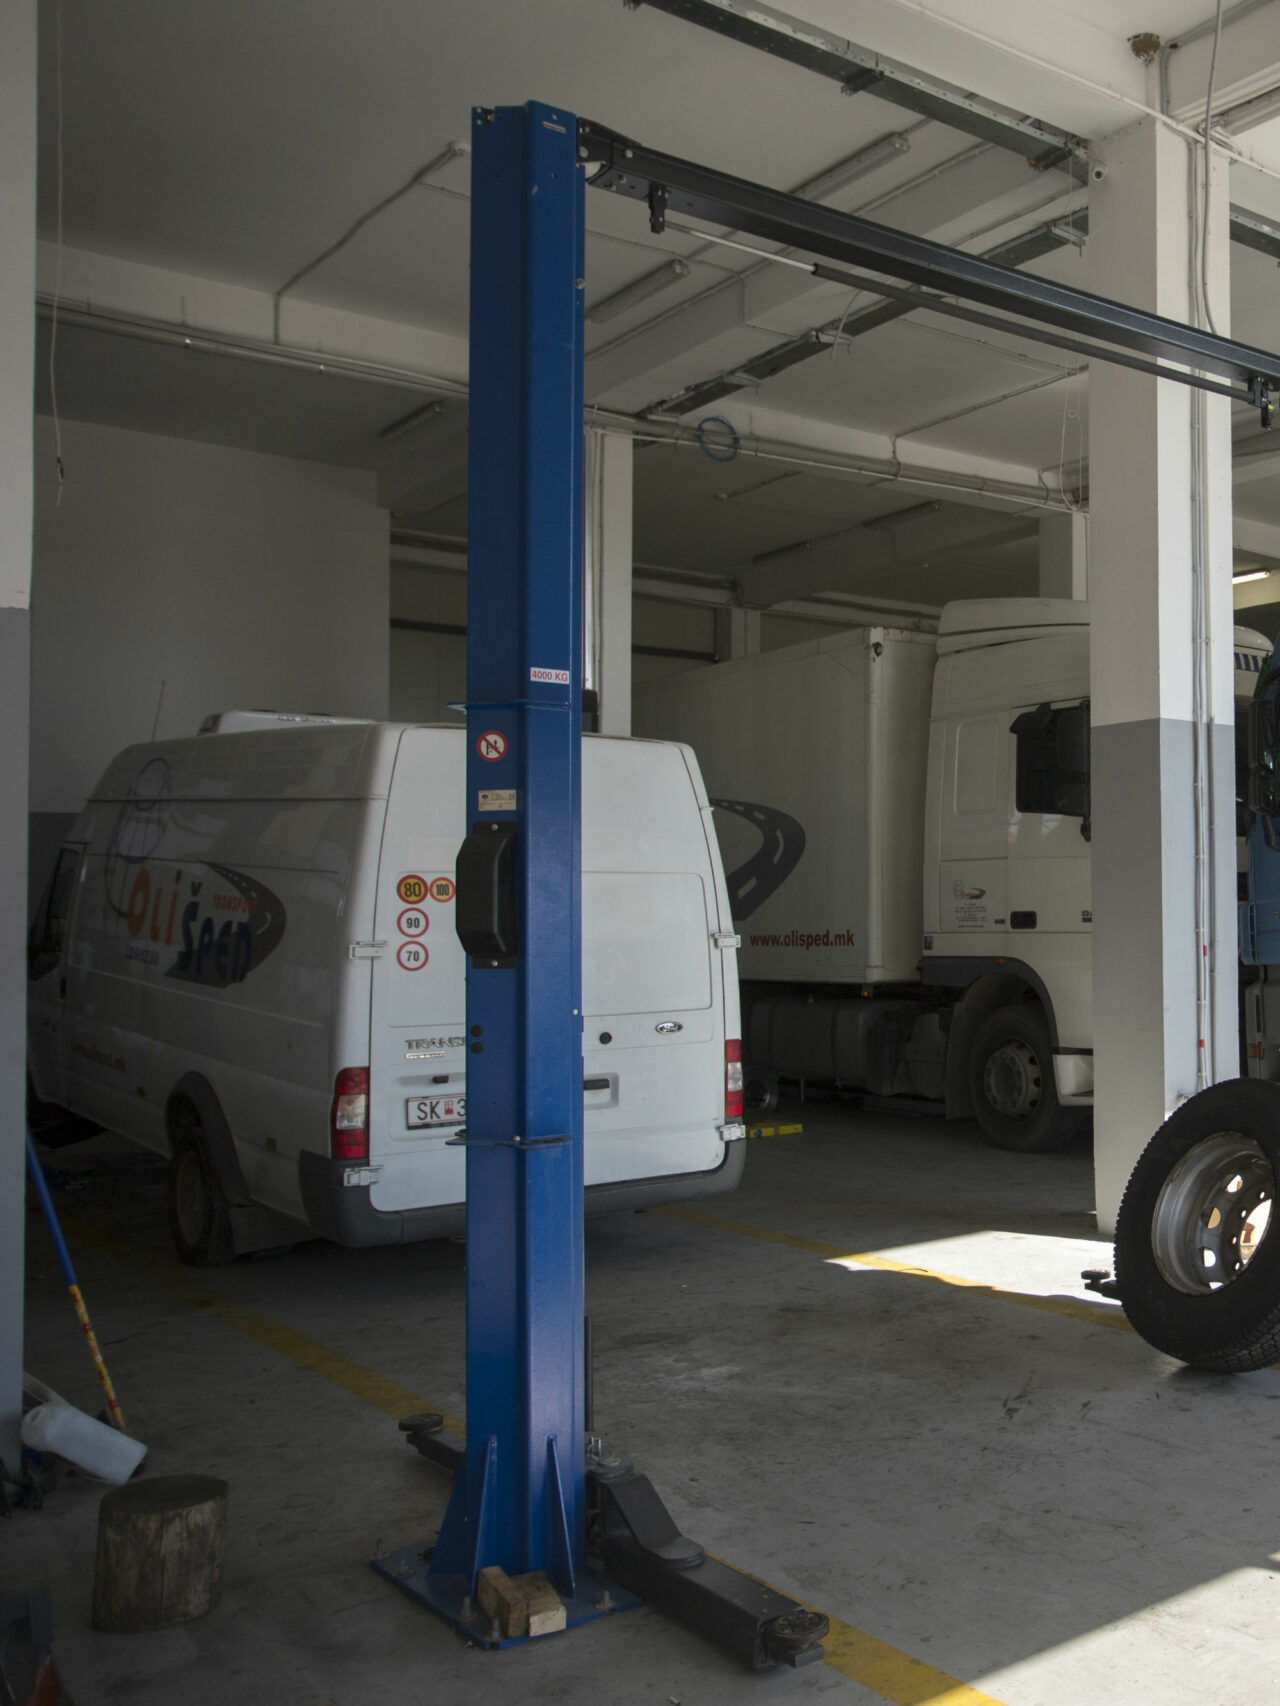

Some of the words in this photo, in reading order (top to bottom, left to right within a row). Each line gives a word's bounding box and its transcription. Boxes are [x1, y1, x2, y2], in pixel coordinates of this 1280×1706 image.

[532, 670, 552, 681] 4000
[555, 672, 568, 682] KG
[404, 882, 422, 898] 80
[436, 884, 450, 896] 100
[406, 917, 420, 928] 90
[750, 929, 855, 951] www.olisped.mk
[406, 951, 420, 962] 70
[404, 1037, 466, 1050] TRANS
[417, 1101, 441, 1121] SK
